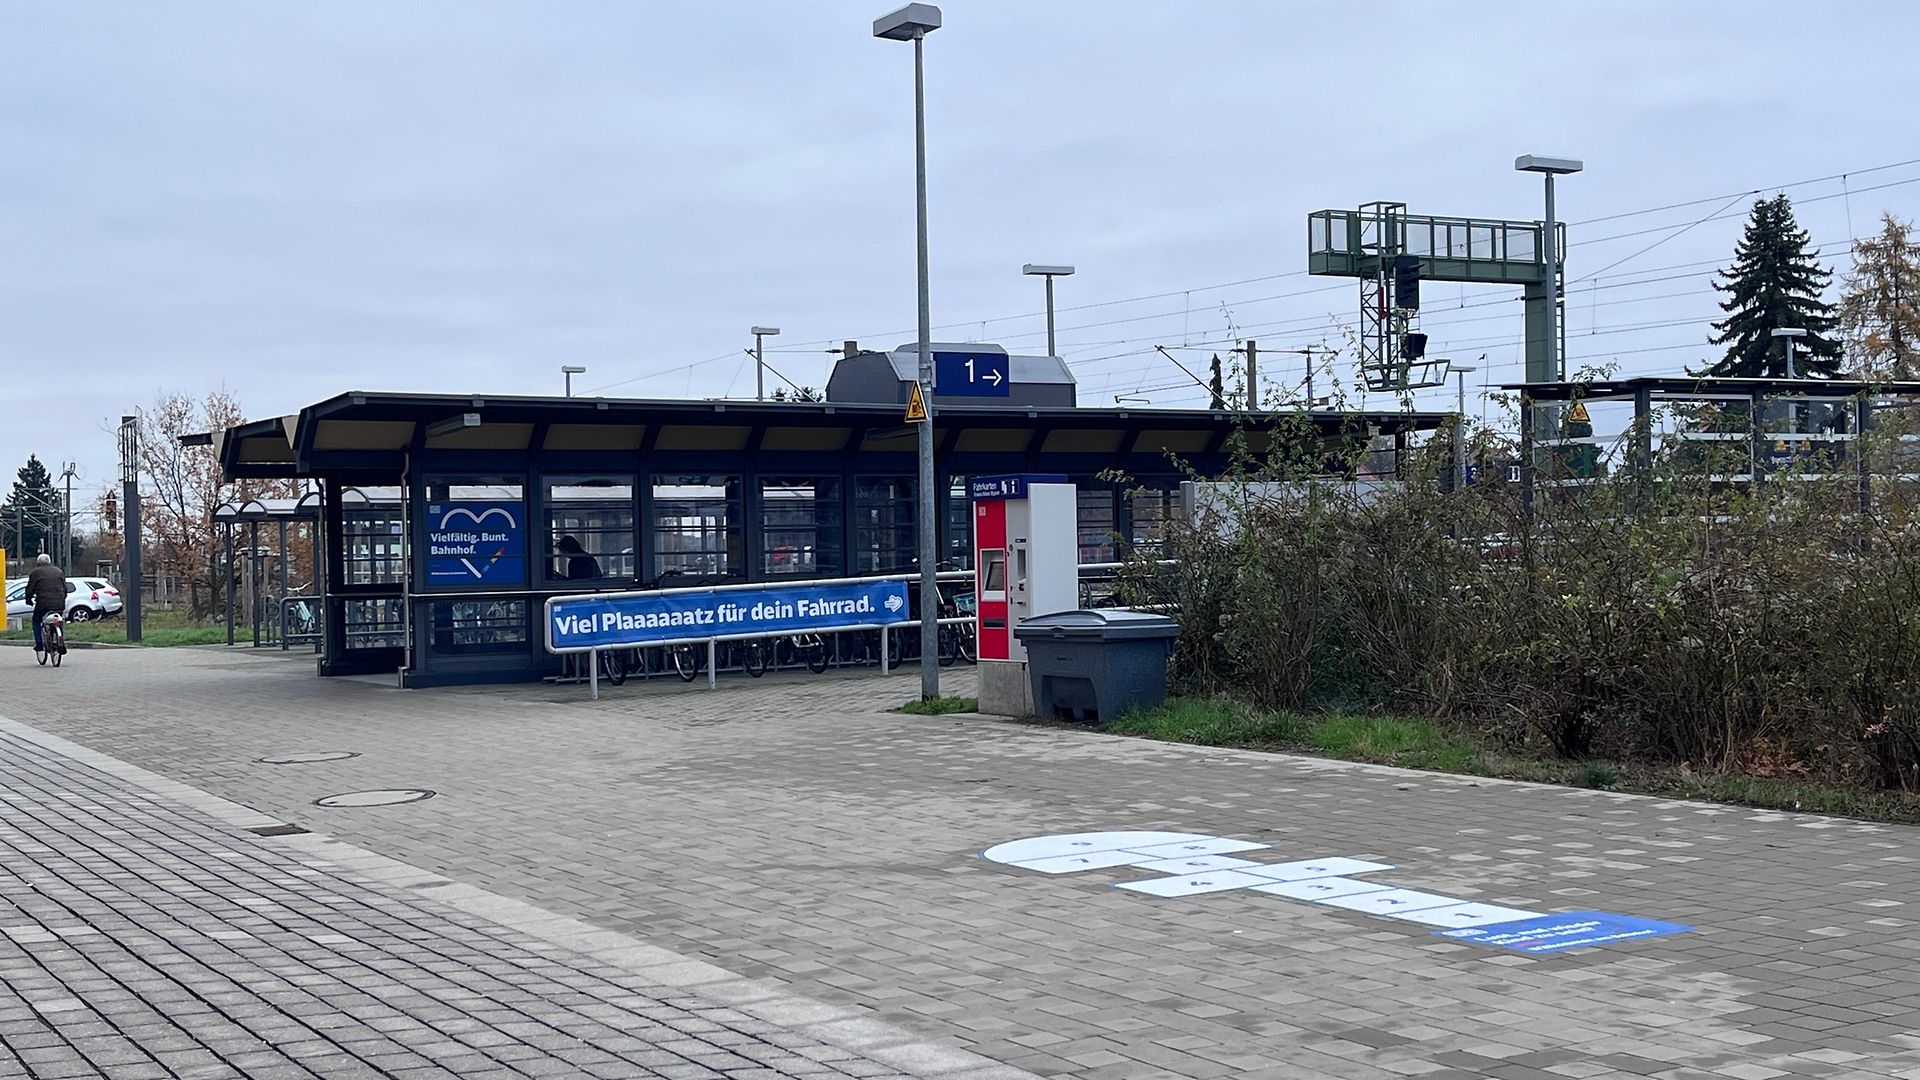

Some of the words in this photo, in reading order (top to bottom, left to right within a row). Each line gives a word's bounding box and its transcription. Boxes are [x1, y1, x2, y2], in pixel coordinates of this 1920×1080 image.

[964, 358, 974, 383] 1
[973, 482, 997, 491] Fahrkarten
[430, 532, 480, 544] Vielfältig.
[481, 532, 509, 542] Bunt.
[430, 545, 477, 555] Bahnhof.
[555, 613, 598, 636] Viel
[602, 608, 715, 632] Plaaaaaatz
[717, 603, 747, 624] für
[751, 600, 794, 621] dein
[797, 594, 876, 618] Fahrrad.
